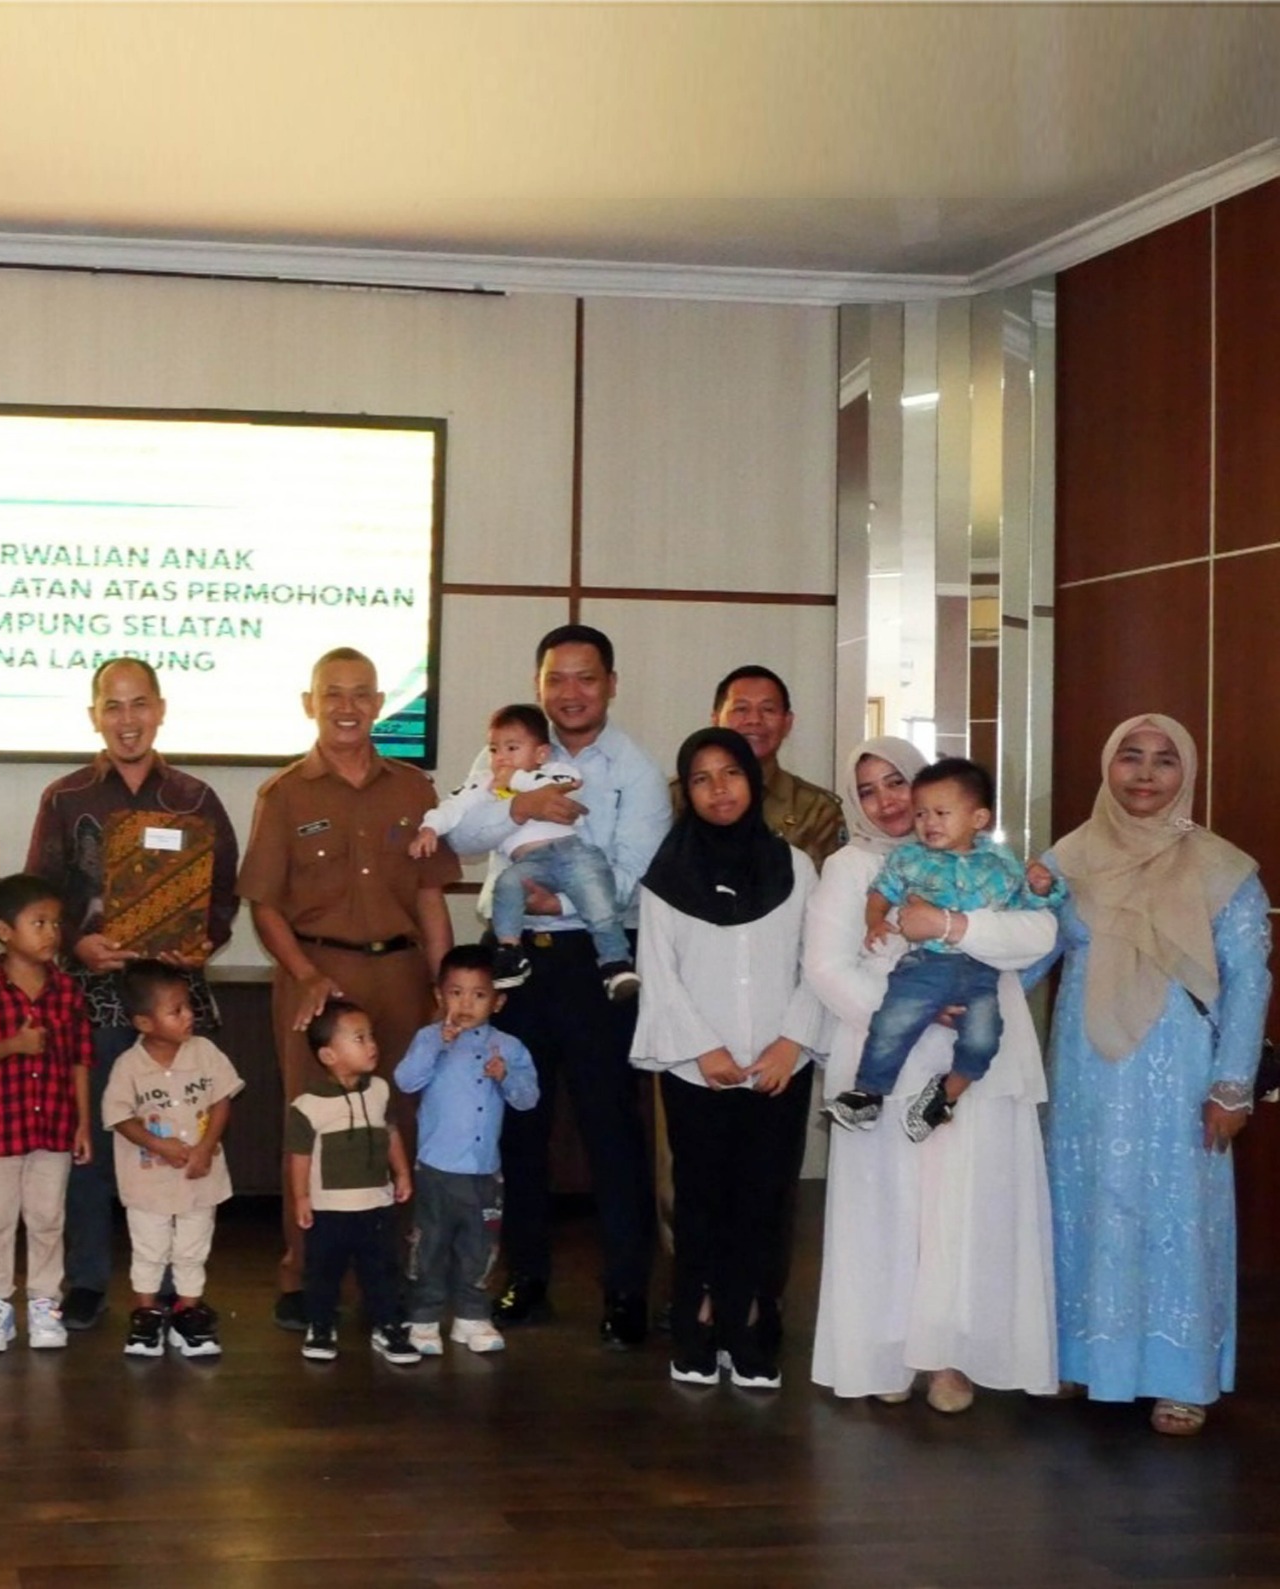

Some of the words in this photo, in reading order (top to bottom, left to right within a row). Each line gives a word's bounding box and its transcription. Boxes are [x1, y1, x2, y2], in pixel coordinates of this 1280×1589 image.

[160, 547, 254, 571] ANAK
[104, 579, 178, 602] ATAS
[188, 581, 414, 607] PERMOHONAN
[123, 615, 262, 639] SELATAN
